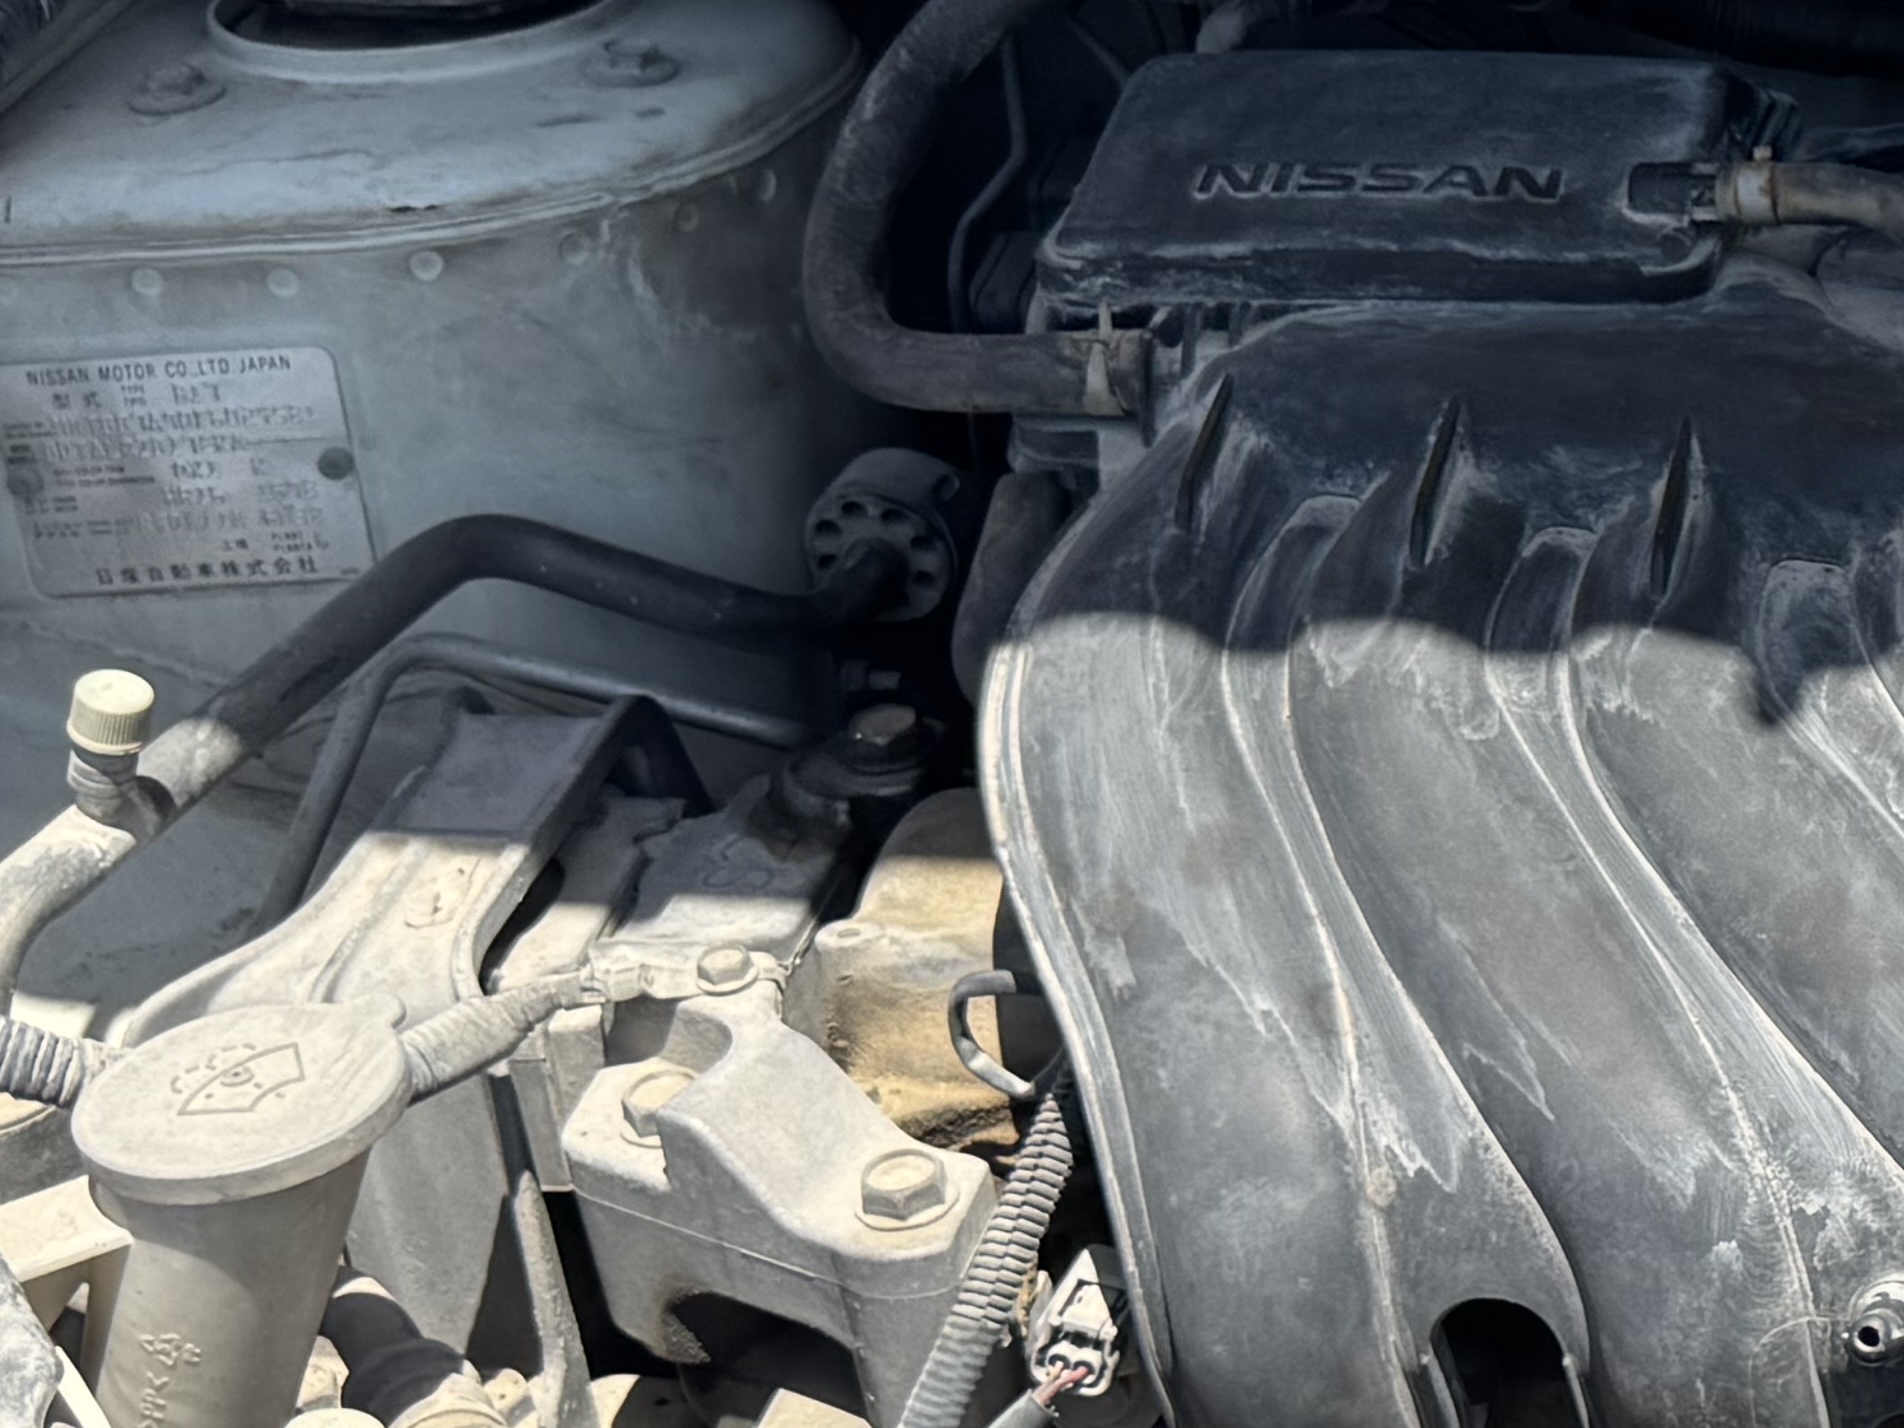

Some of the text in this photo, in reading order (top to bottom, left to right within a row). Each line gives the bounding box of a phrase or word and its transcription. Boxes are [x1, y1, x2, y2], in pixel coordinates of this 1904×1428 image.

[1194, 162, 1564, 202] NISSAN
[26, 367, 90, 386] NISSAN
[99, 362, 157, 382] MOTOR
[239, 354, 291, 374] JAPAN
